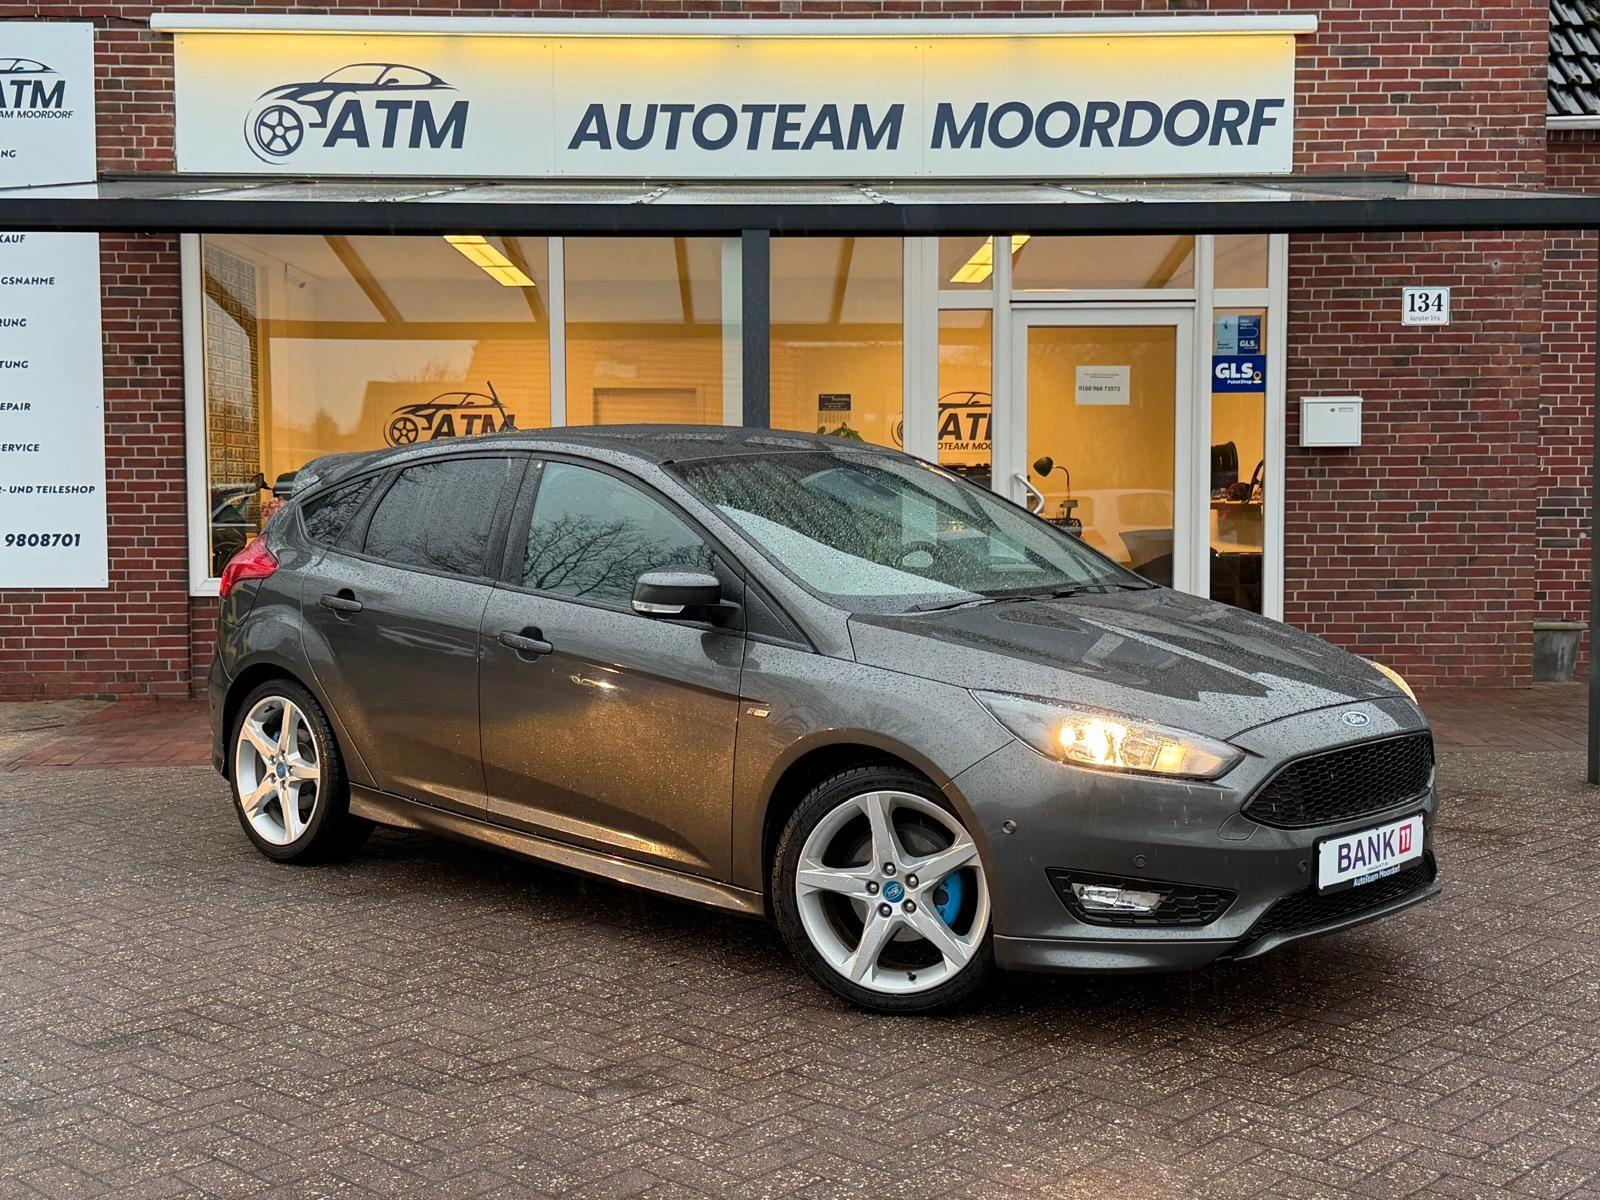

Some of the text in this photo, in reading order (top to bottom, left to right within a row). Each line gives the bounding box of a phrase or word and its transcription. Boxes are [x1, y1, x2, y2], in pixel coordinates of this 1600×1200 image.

[0, 80, 65, 108] TM
[17, 110, 74, 119] MOORDORF
[323, 99, 469, 149] ATM
[567, 98, 1286, 150] AUTOTEAM MOORDORF
[1, 149, 16, 158] NG
[1, 276, 55, 285] GSNAHME
[1408, 292, 1444, 312] 134
[1215, 362, 1254, 379] GLS
[938, 412, 992, 441] AT
[0, 443, 40, 452] ERVICE
[9, 485, 33, 494] UND
[36, 485, 96, 494] TEILESHOP
[5, 533, 81, 547] 9808701
[1338, 829, 1396, 873] BANK
